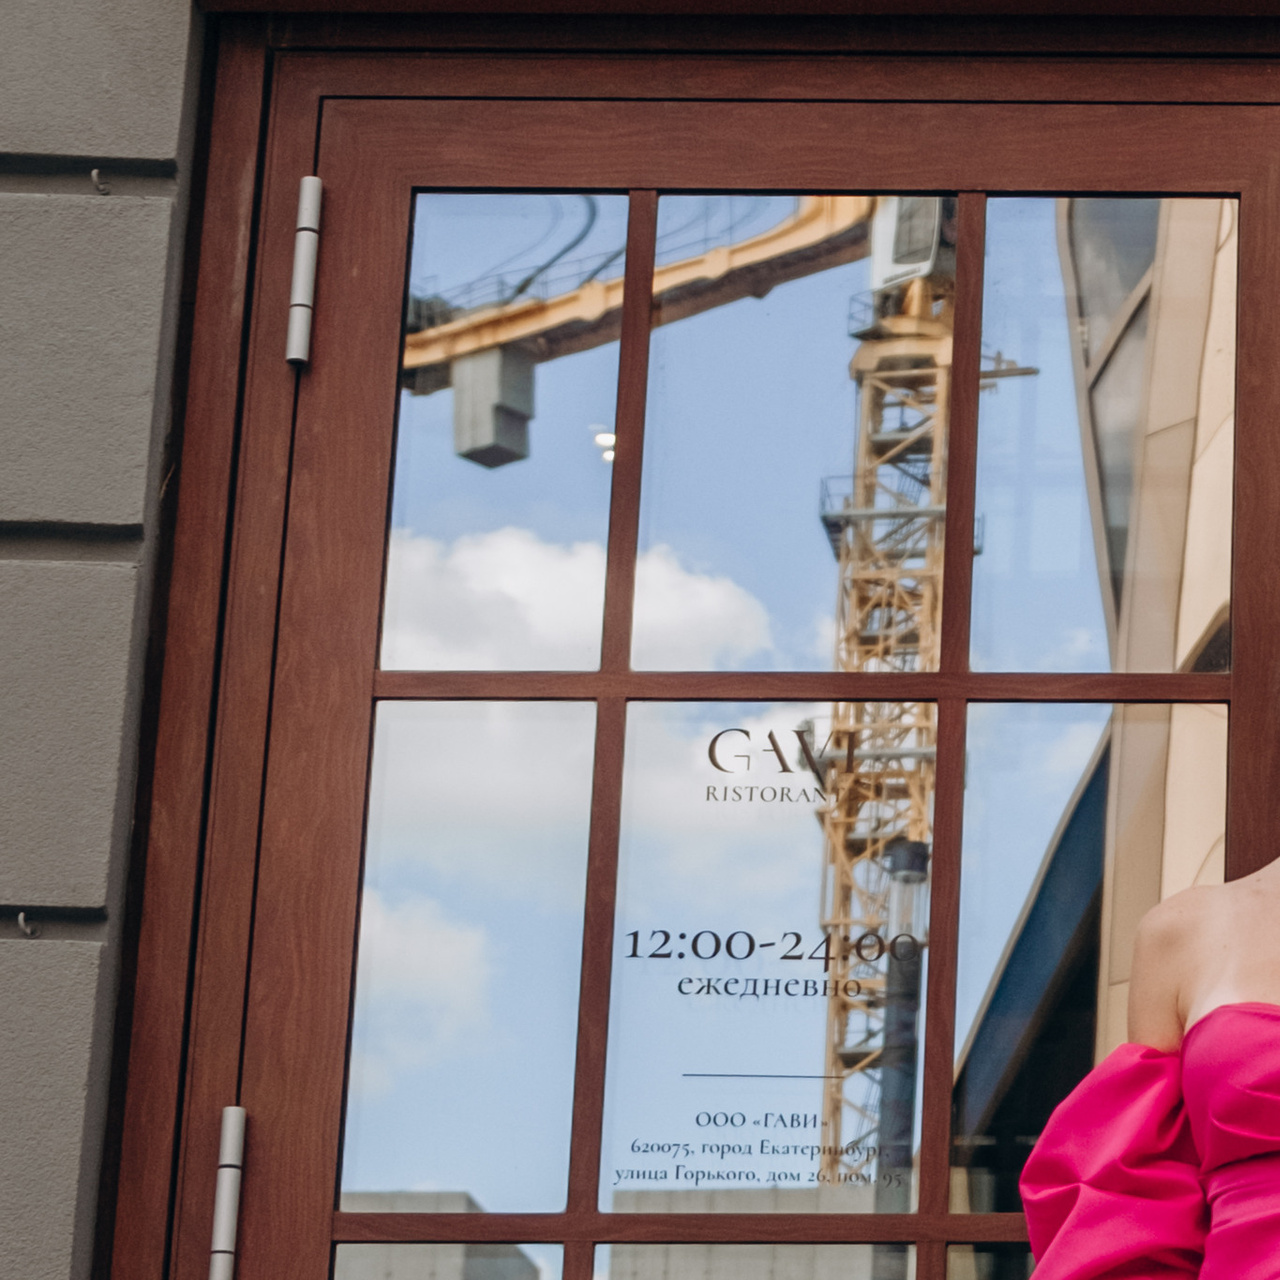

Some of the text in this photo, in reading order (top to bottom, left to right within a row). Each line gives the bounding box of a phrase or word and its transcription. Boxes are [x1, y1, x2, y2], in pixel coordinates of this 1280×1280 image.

[707, 727, 858, 774] GAVI
[624, 929, 920, 973] 12:00-24:00
[677, 974, 862, 1000] ежедневно
[630, 1137, 696, 1159] 620075,
[701, 1142, 753, 1160] город
[612, 1169, 668, 1186] улица
[675, 1164, 761, 1187] Горького,
[765, 1170, 801, 1183] дом
